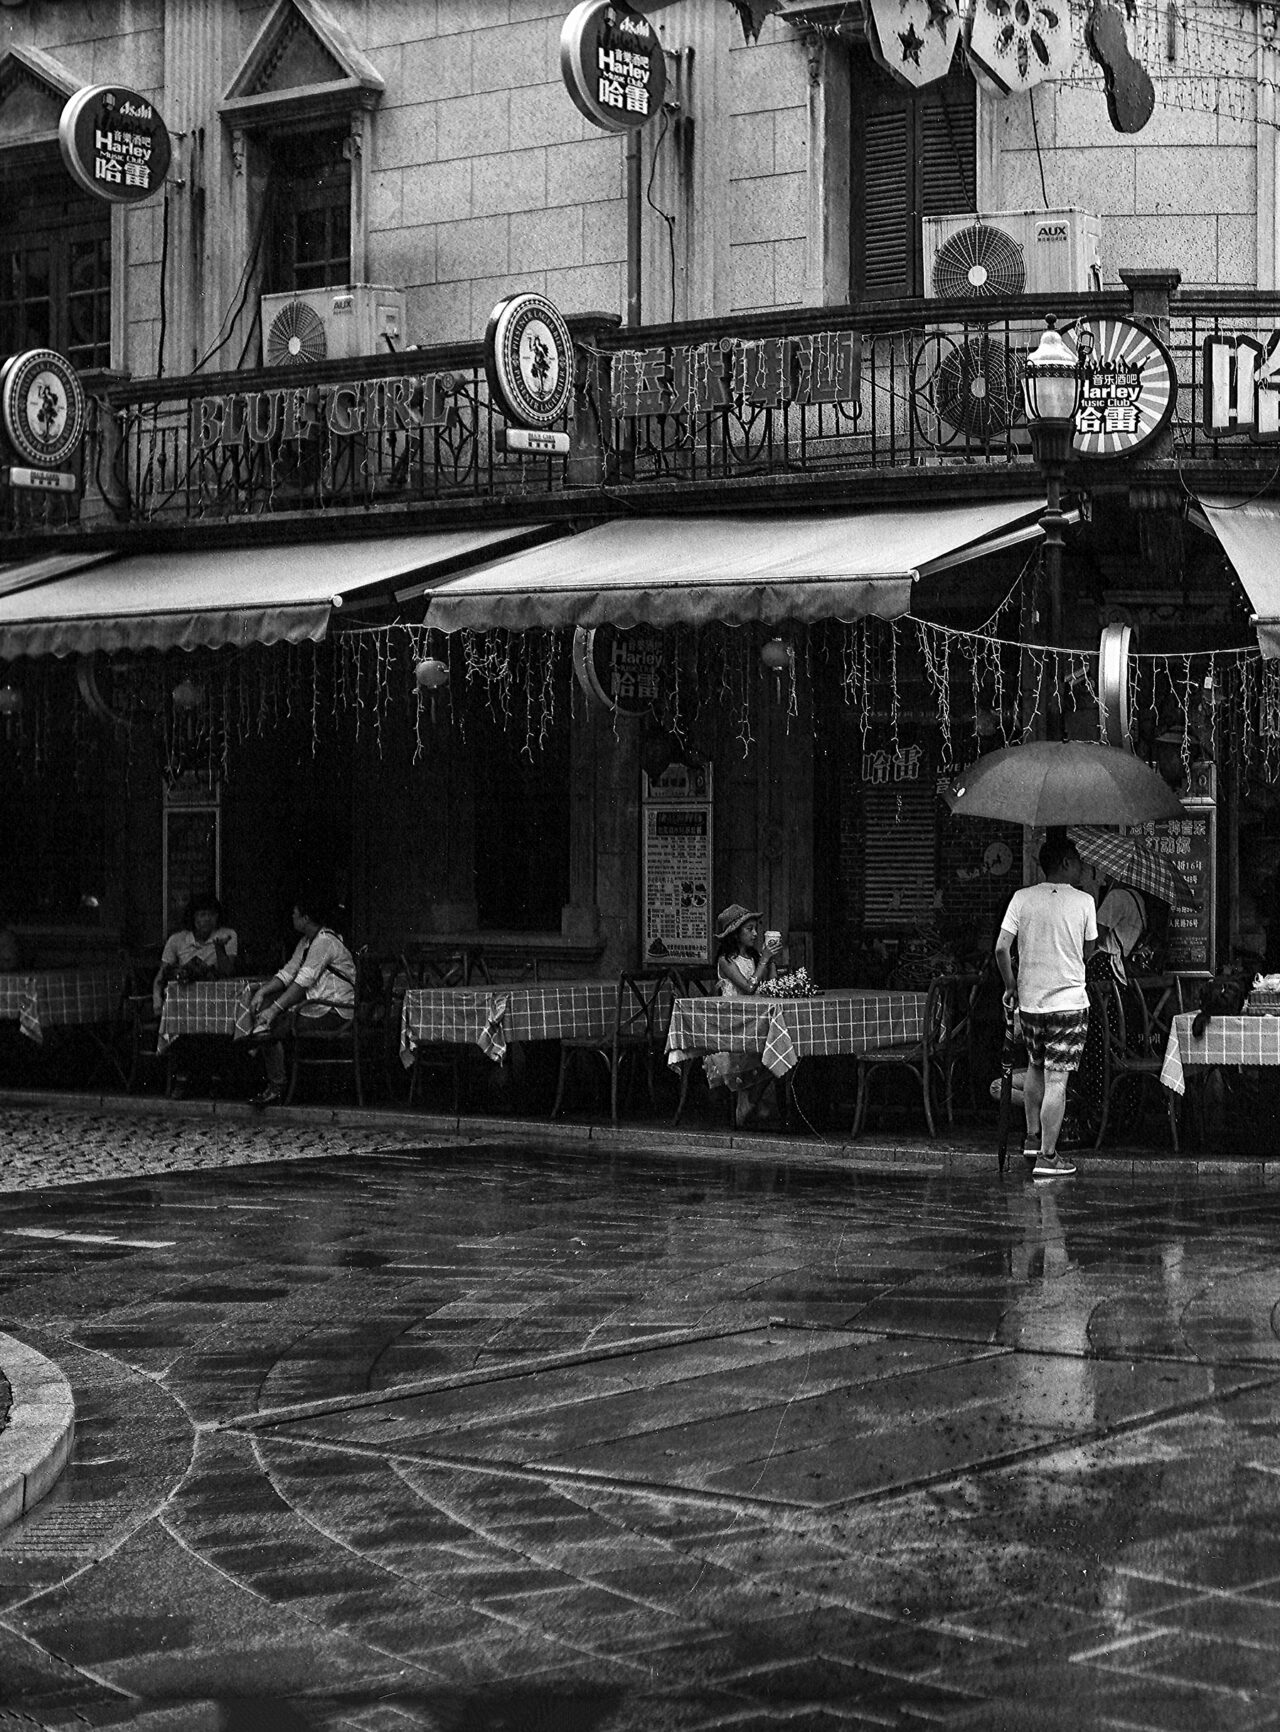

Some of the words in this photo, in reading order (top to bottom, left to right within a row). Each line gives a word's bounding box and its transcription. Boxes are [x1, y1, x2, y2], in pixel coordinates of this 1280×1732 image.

[598, 47, 650, 83] Harley
[120, 101, 152, 119] Asahi
[599, 78, 649, 114] 哈雷
[95, 130, 152, 160] Harley
[95, 157, 151, 188] 哈雷
[1038, 226, 1066, 236] AUX
[1093, 374, 1138, 386] 音乐酒吧
[191, 390, 314, 449] BLUE
[328, 375, 449, 435] GIRL
[1107, 398, 1131, 407] Club
